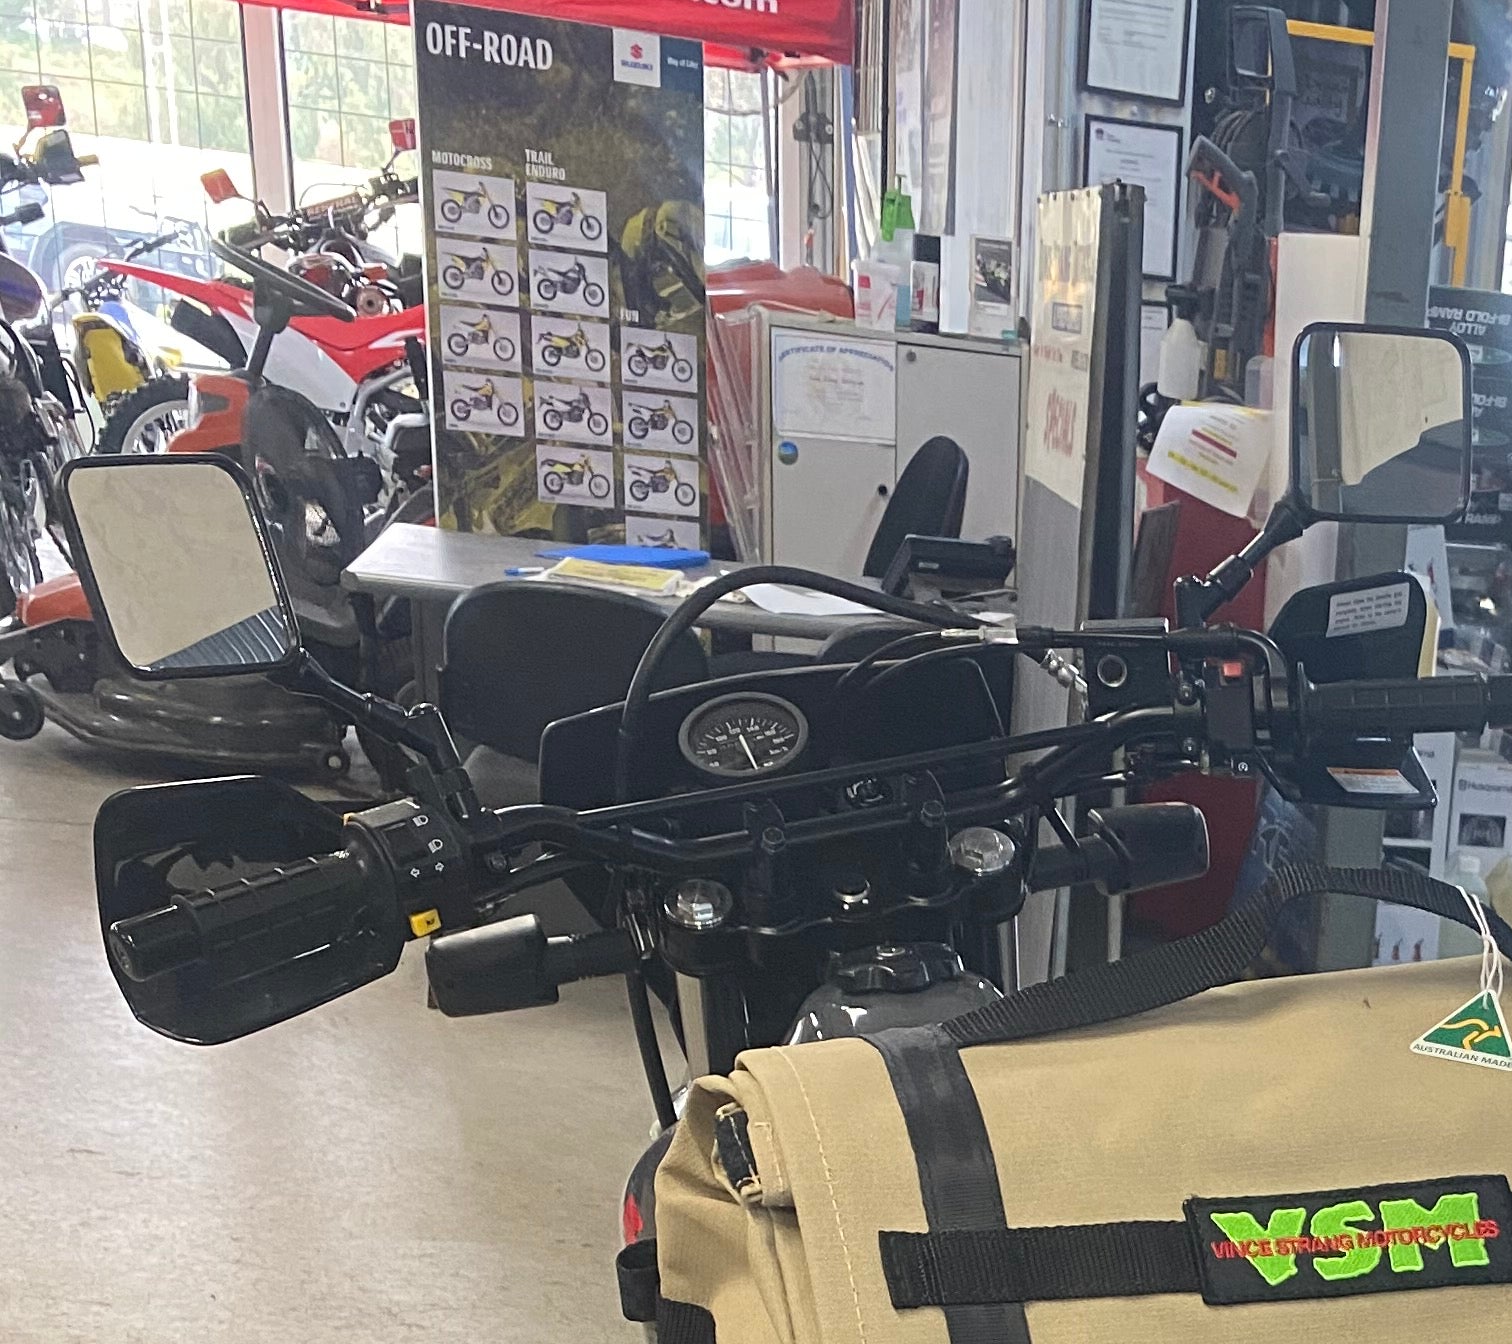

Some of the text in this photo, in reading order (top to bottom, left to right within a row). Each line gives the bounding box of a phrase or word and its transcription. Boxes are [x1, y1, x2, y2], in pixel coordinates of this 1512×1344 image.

[426, 21, 553, 71] OFF-ROAD
[432, 150, 492, 170] MOTOCROSS
[525, 148, 554, 165] TRAIL
[525, 163, 565, 180] ENDURO
[1413, 1043, 1479, 1063] AUSTRALIAN
[1210, 1218, 1501, 1260] VINCE STRANG MOTORCYCLES
[1210, 1192, 1490, 1287] VSM
